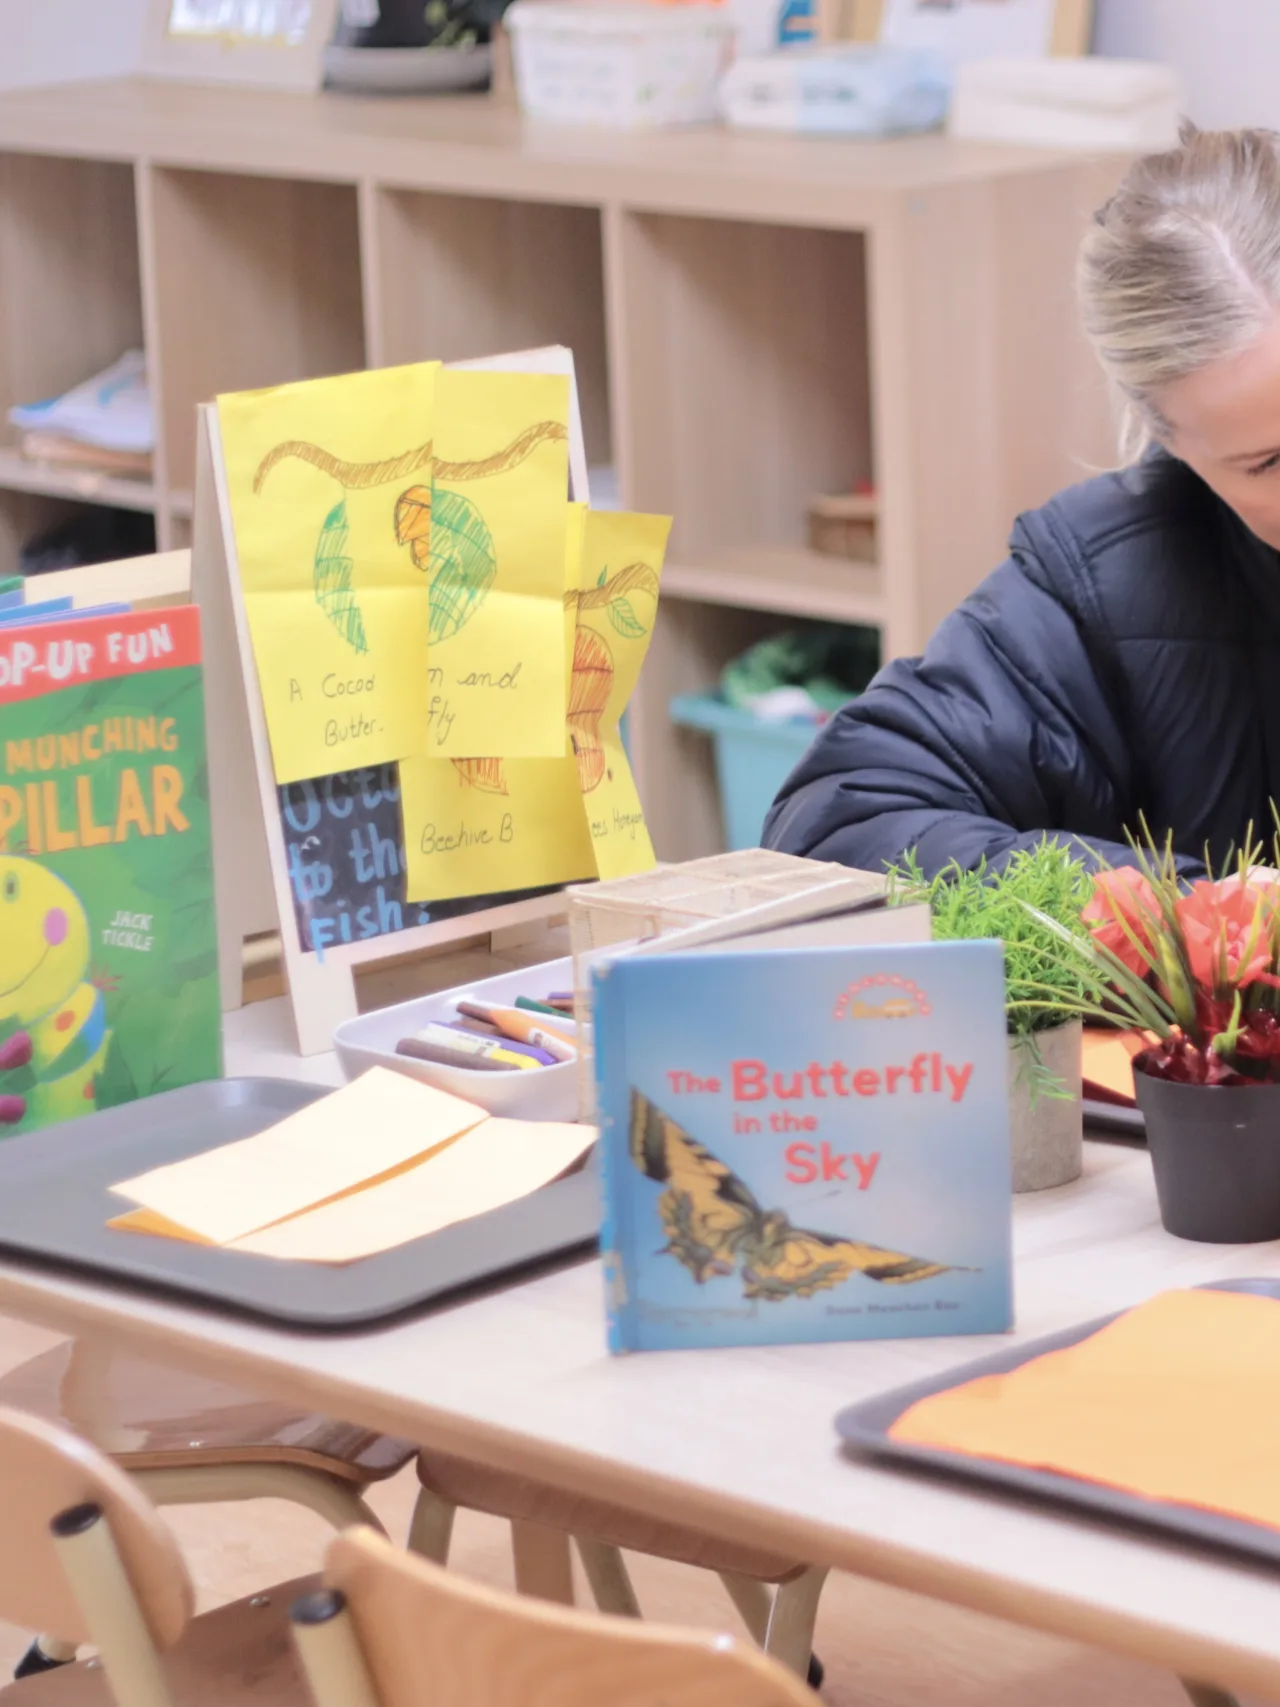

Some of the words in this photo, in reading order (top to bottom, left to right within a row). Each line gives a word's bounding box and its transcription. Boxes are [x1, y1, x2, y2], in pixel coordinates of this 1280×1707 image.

[107, 623, 173, 663] FUN
[290, 678, 303, 702] A
[457, 662, 522, 689] and
[428, 695, 456, 746] fly
[6, 716, 179, 776] MUNCHING
[348, 822, 407, 883] th
[421, 820, 493, 854] Beehive
[500, 812, 513, 843] B
[102, 929, 155, 951] TICKLE
[109, 910, 154, 931] JACK
[666, 1070, 721, 1094] The
[731, 1052, 975, 1103] Butterfly
[733, 1112, 762, 1134] in
[769, 1110, 819, 1134] the
[784, 1141, 881, 1191] Sky
